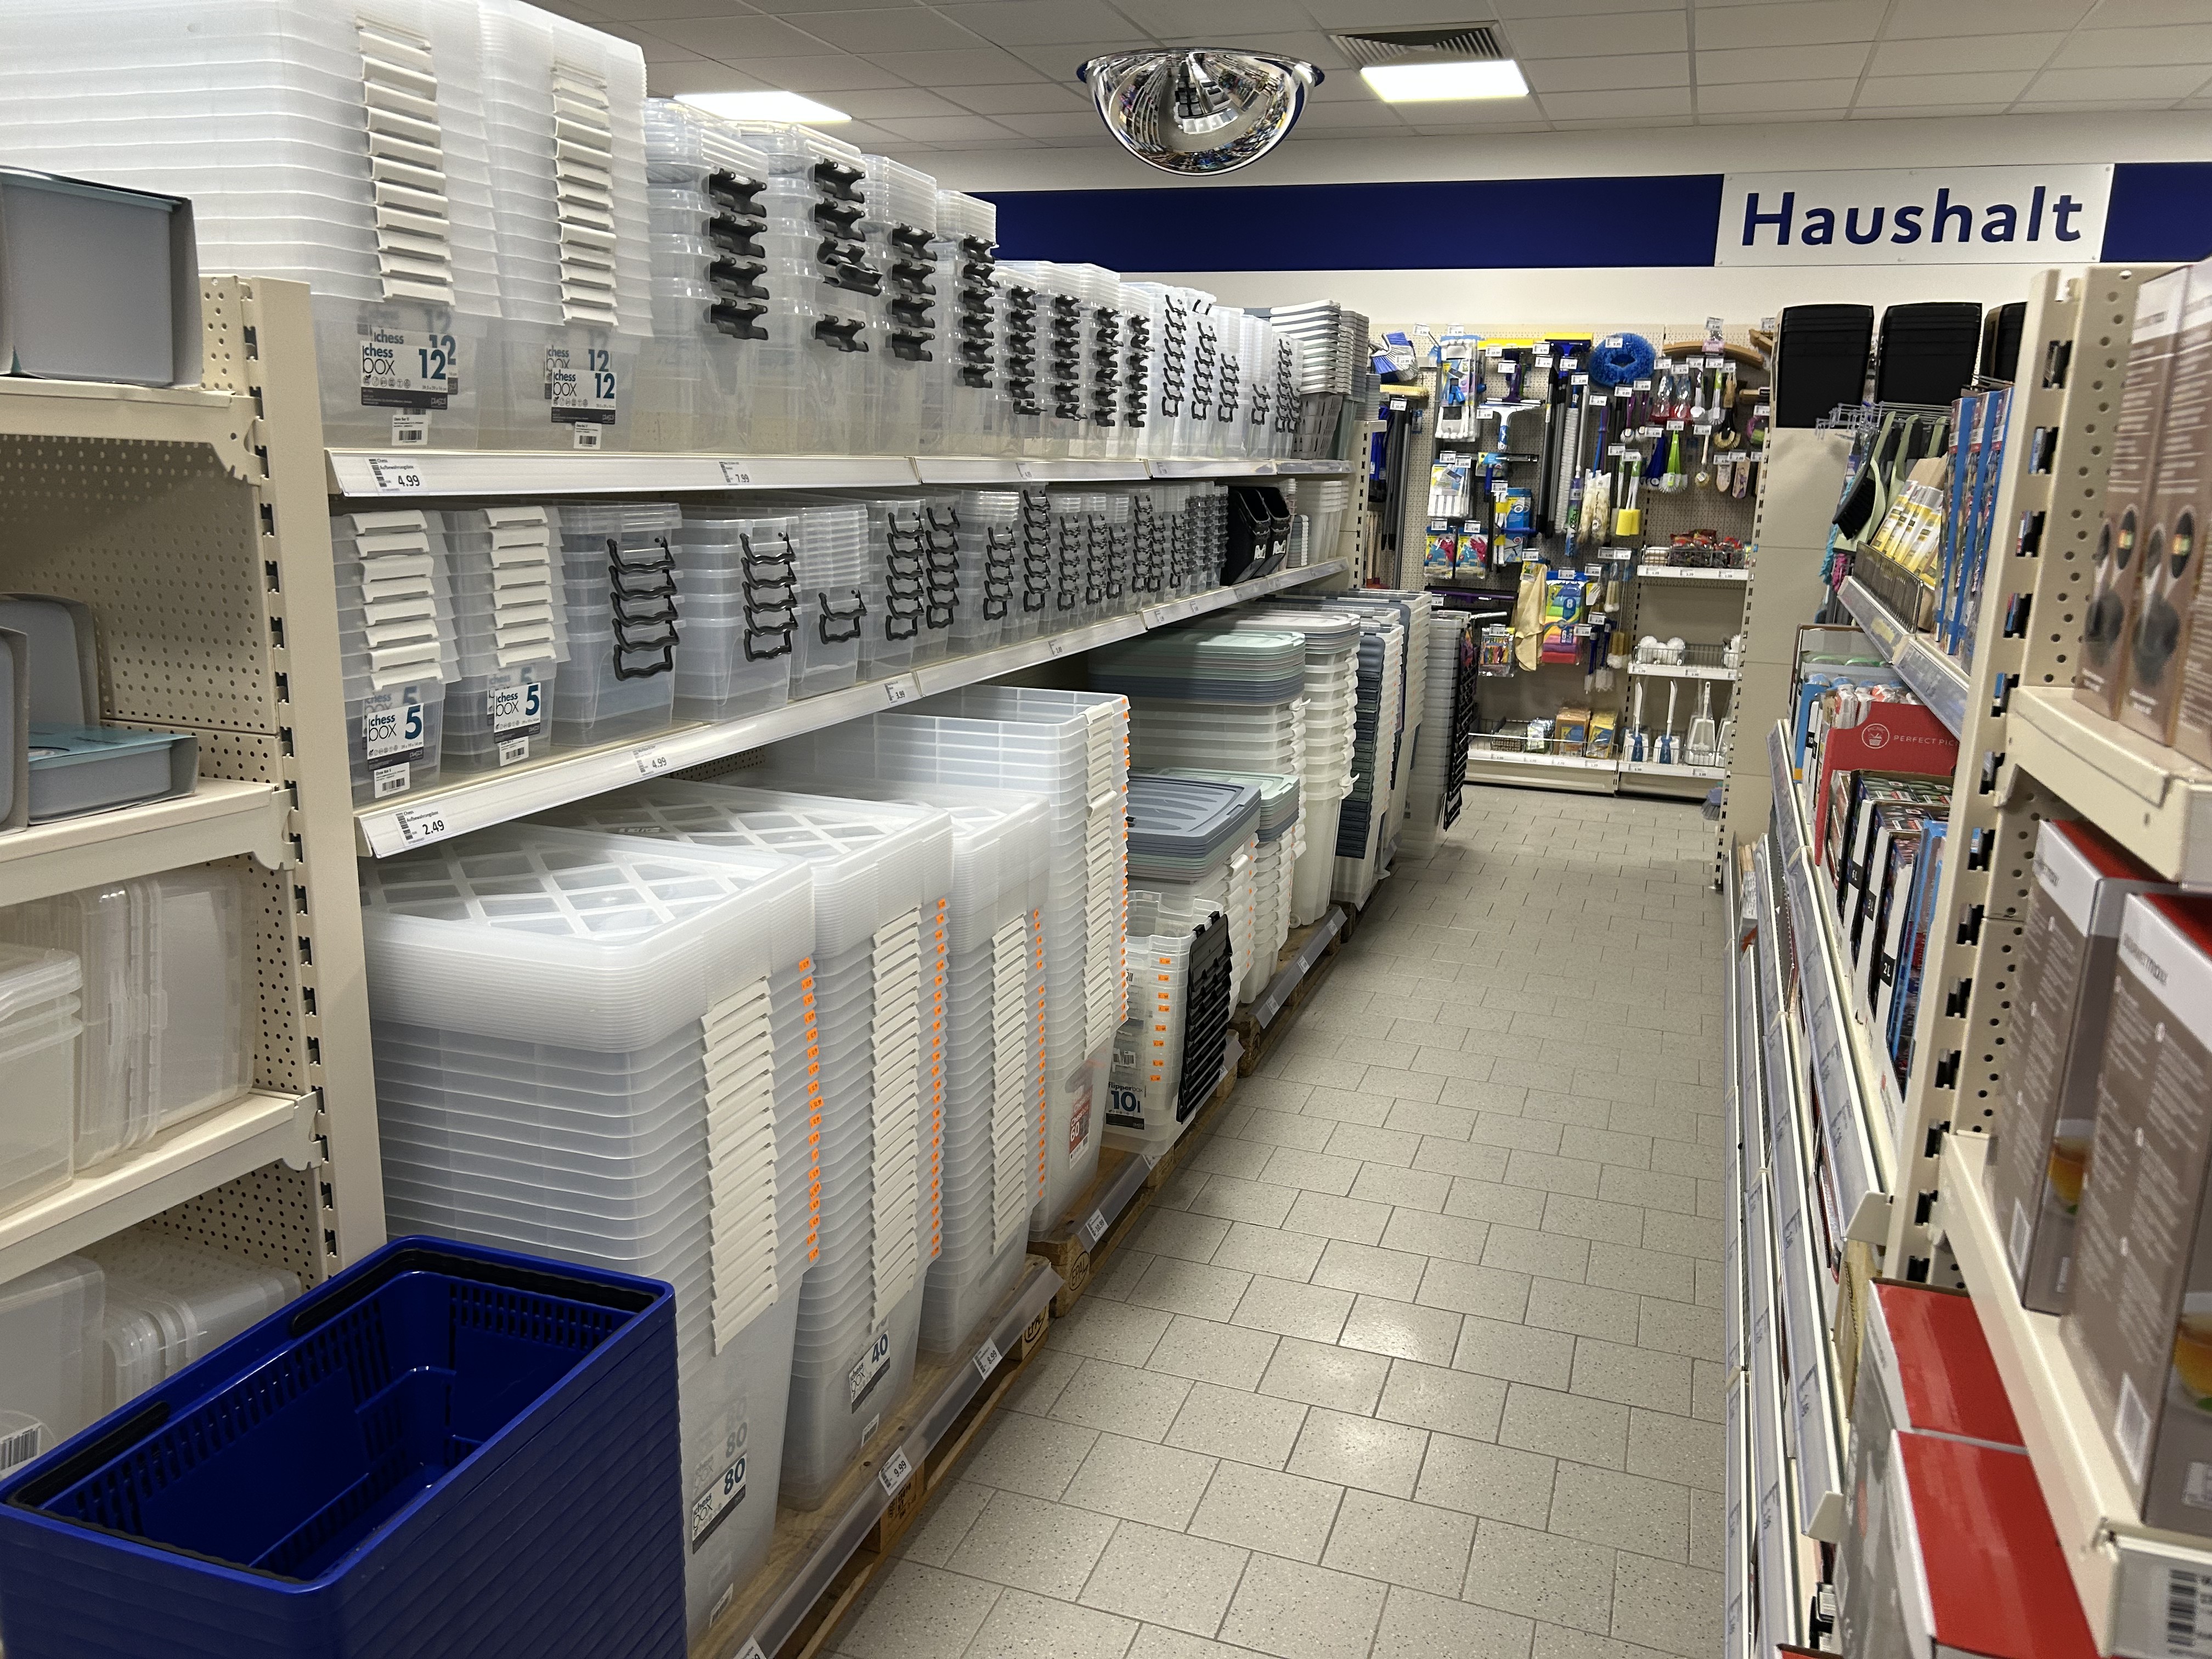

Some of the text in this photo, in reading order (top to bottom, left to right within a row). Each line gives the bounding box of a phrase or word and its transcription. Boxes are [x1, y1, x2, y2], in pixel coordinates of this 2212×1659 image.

[1741, 186, 2083, 246] Haushalt
[376, 330, 404, 344] chess
[362, 345, 396, 376] box
[364, 342, 446, 380] chess 12
[548, 346, 610, 372] chess 12
[553, 371, 577, 397] box
[555, 370, 616, 399] chess 12
[398, 475, 420, 487] 4.99
[735, 473, 750, 483] 7.99
[495, 696, 519, 716] box
[497, 684, 540, 716] chess 5
[368, 719, 397, 742] box
[370, 704, 422, 740] chess 5
[1893, 735, 1936, 744] PERFECT
[652, 757, 667, 768] 4.99
[422, 820, 444, 835] 2.49
[1883, 963, 1891, 977] 2L
[1070, 1121, 1080, 1142] 60
[1072, 1256, 1089, 1287] EPAL
[871, 1333, 888, 1364] 40
[987, 1350, 997, 1365] 8.99
[851, 1362, 864, 1381] chess
[725, 1421, 748, 1458] 80
[724, 1457, 746, 1496] 80
[894, 1460, 907, 1477] 9.99
[693, 1492, 712, 1515] chess
